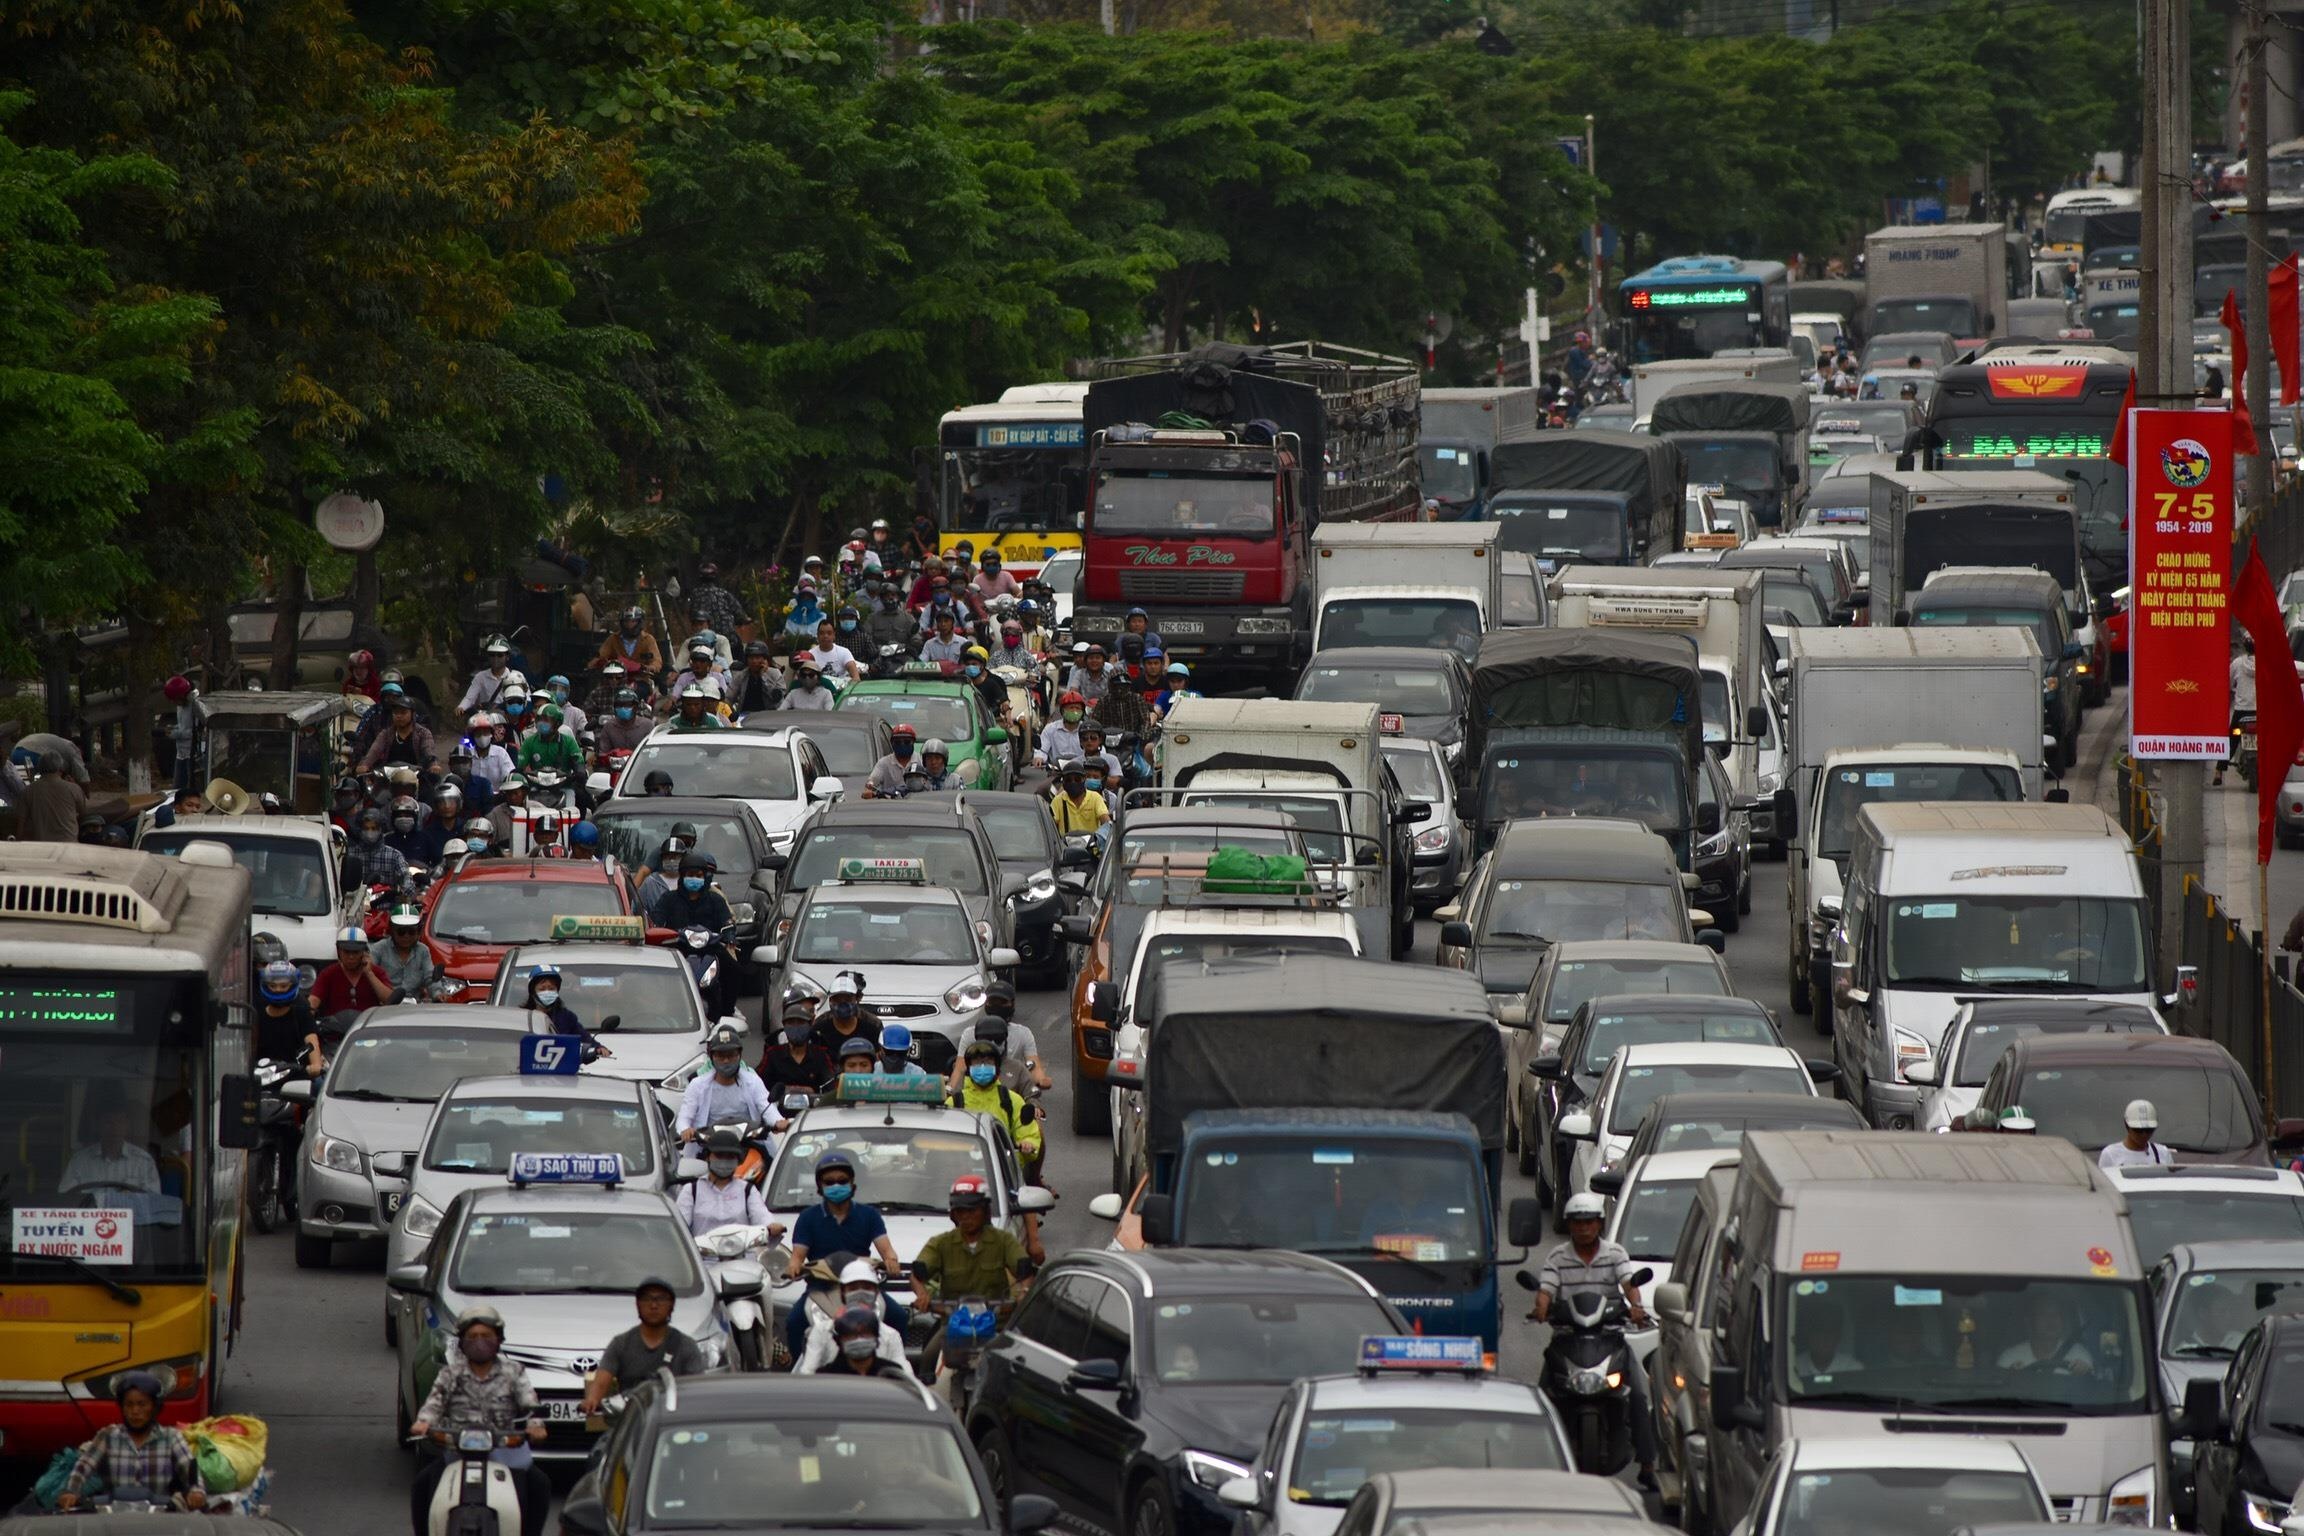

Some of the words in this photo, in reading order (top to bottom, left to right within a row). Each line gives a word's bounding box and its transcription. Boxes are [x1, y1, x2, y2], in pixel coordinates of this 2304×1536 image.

[2025, 375, 2047, 385] VIP
[2155, 521, 2180, 534] 1954
[2188, 521, 2213, 534] 2019
[2160, 569, 2183, 590] NIỆM
[2185, 573, 2198, 588] 65
[2200, 570, 2221, 588] NĂM
[2140, 588, 2165, 607] NGÀY
[2166, 587, 2193, 608] CHIẾN
[1655, 607, 1685, 615] THERMO
[2150, 611, 2171, 629] ĐIỆN
[2173, 610, 2195, 627] BIÊN
[907, 661, 938, 670] TAXI
[2138, 738, 2166, 756] QUẬN
[2168, 739, 2203, 754] HOÀNG
[2205, 742, 2225, 754] MAI
[534, 1039, 566, 1070] G7
[847, 1080, 871, 1088] TAXI
[543, 1159, 568, 1174] SAO
[20, 1211, 37, 1219] XE
[21, 1221, 85, 1237] TUYẾN
[82, 1240, 123, 1257] NGẦM
